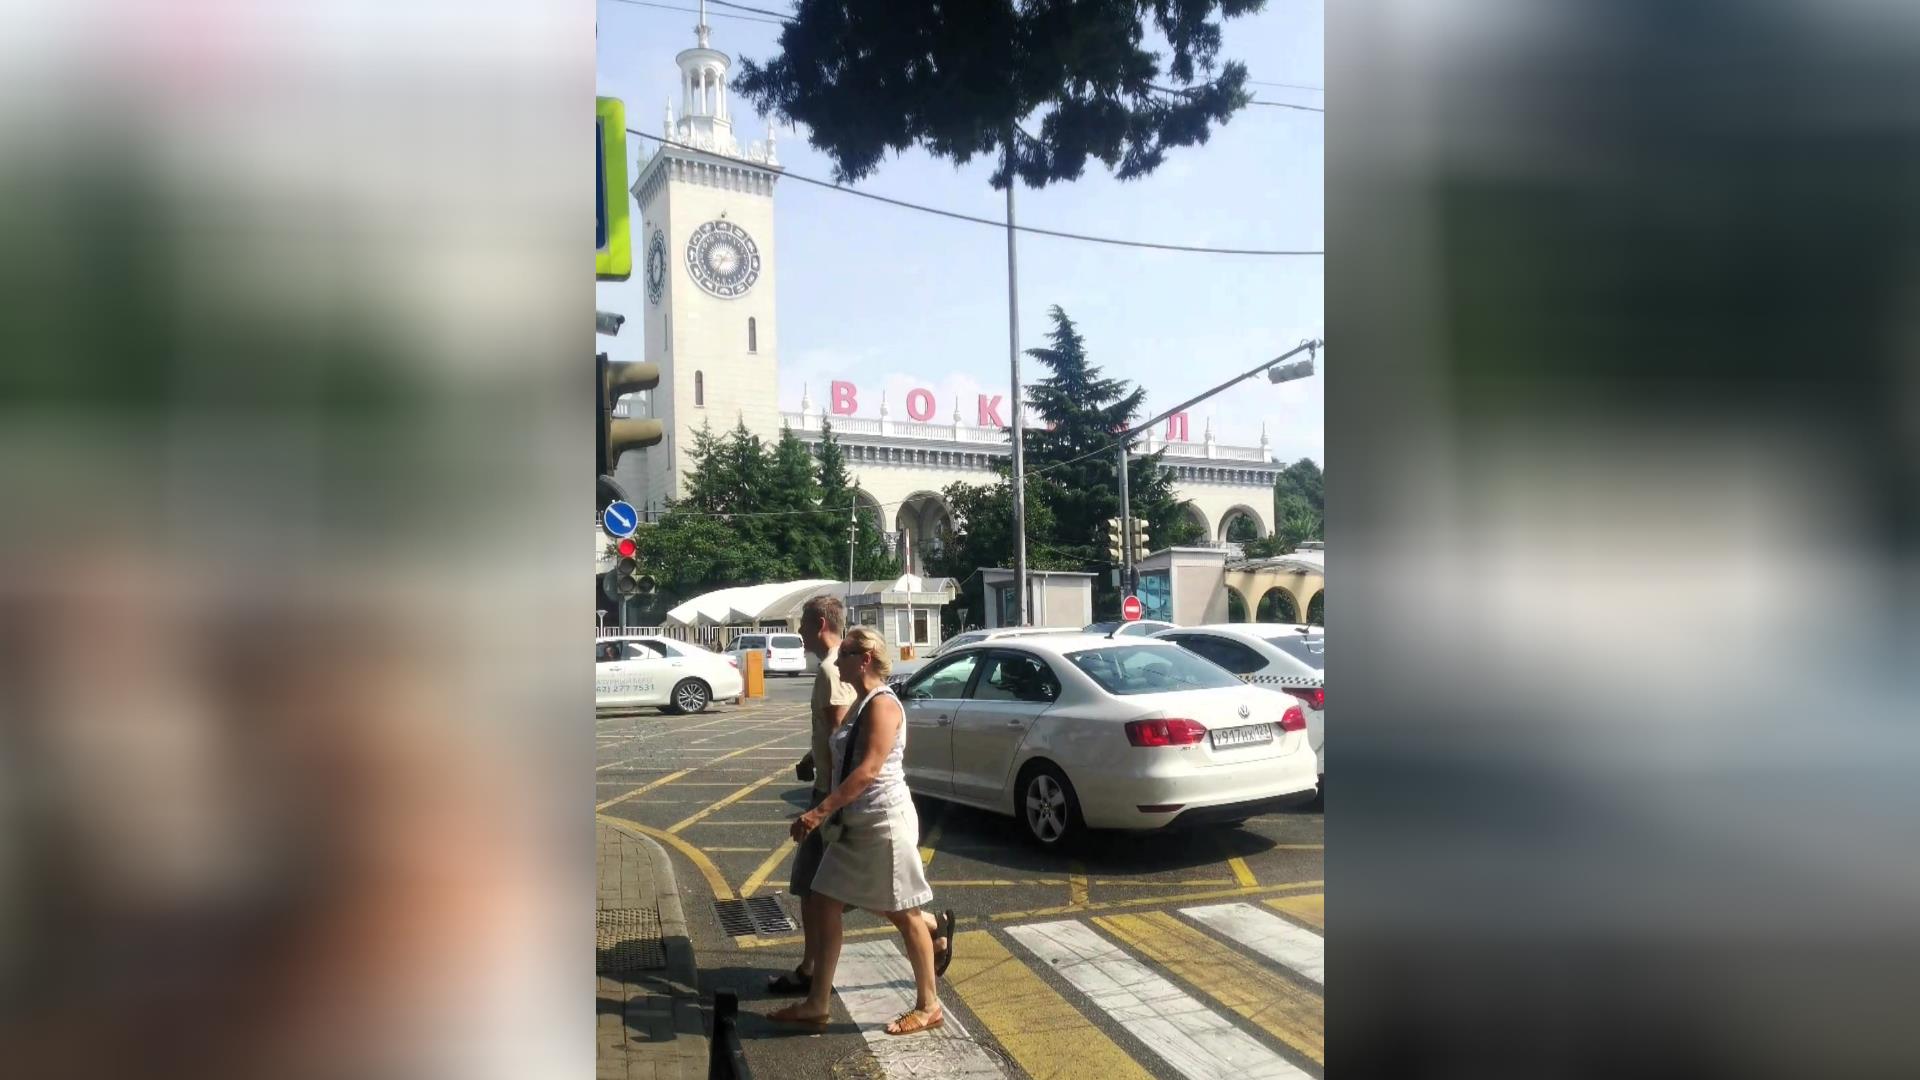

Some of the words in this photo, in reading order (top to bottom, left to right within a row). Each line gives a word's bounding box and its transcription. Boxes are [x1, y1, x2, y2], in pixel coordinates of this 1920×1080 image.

[831, 380, 1189, 442] ВОКЛ
[613, 684, 630, 693] 277
[633, 683, 655, 691] 7531
